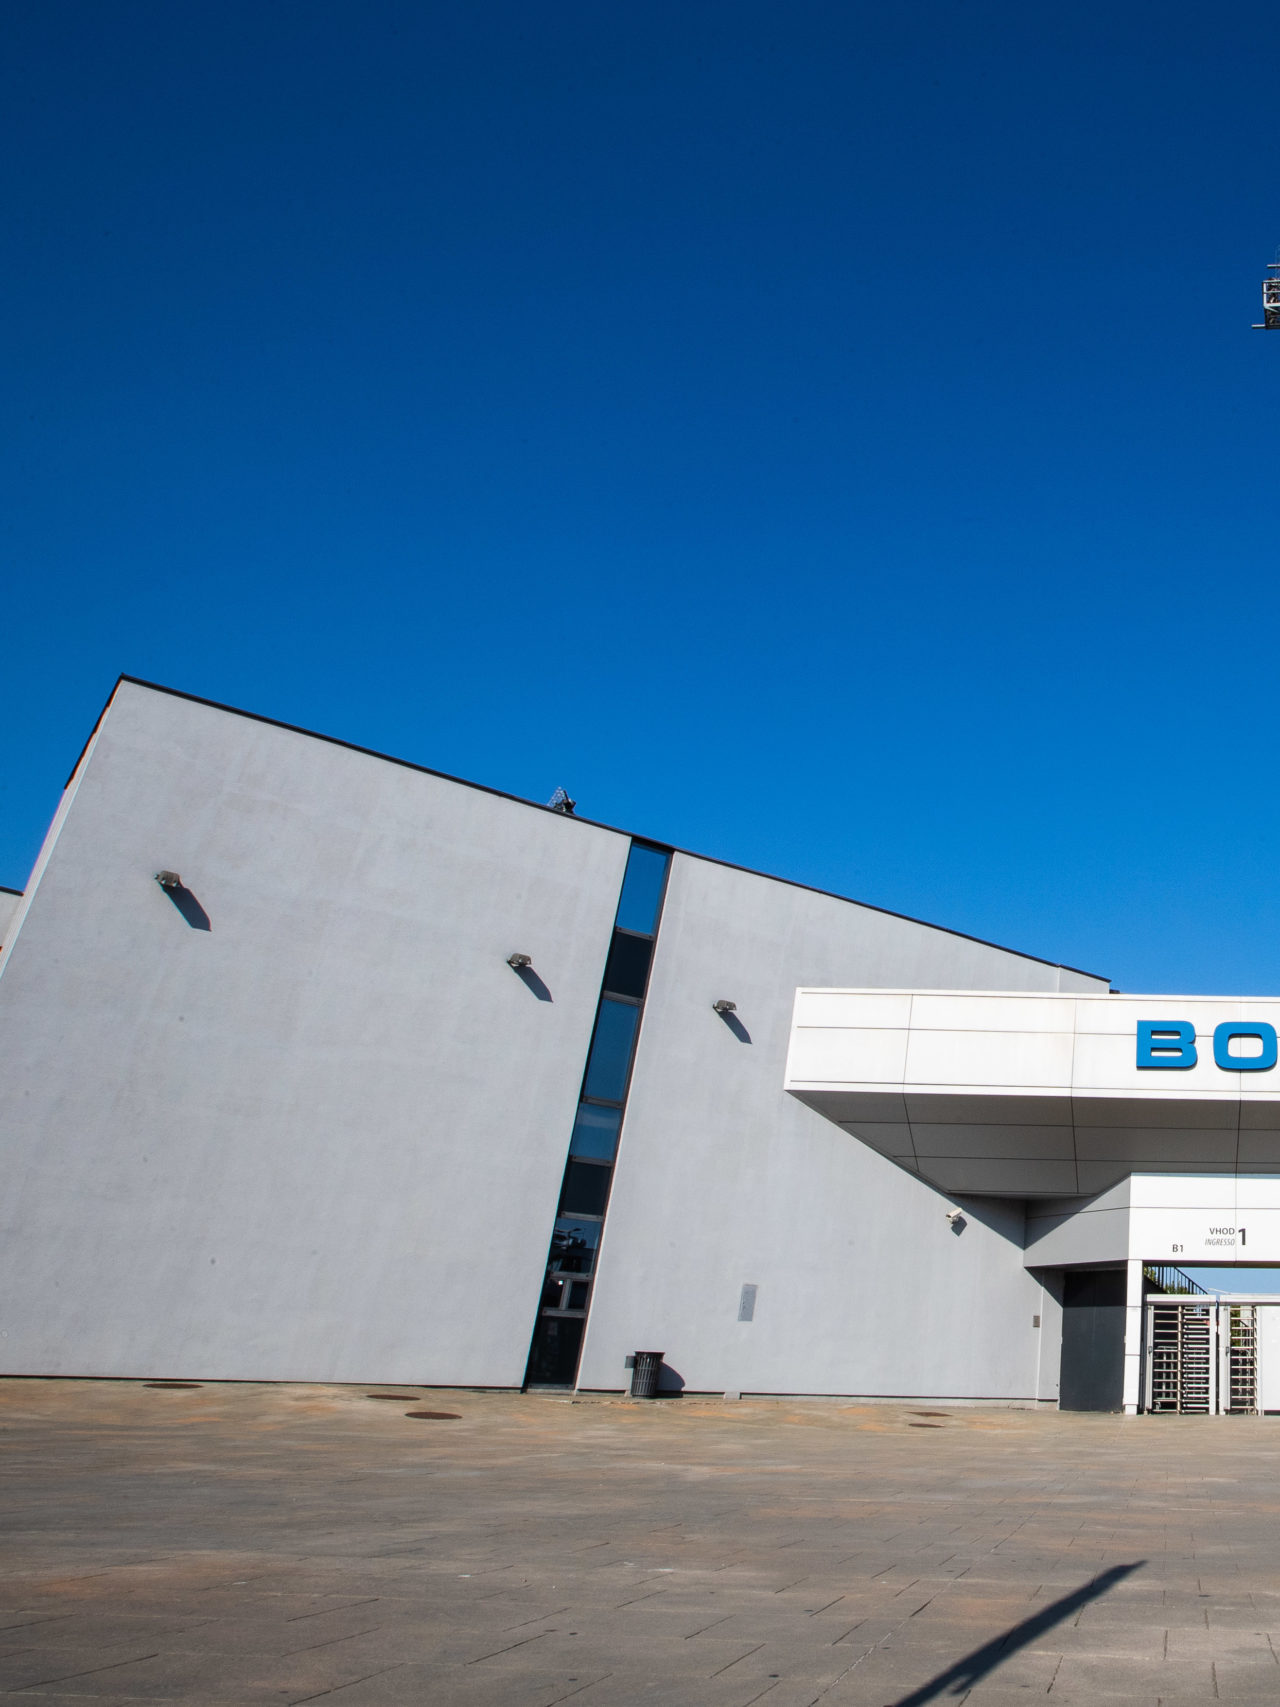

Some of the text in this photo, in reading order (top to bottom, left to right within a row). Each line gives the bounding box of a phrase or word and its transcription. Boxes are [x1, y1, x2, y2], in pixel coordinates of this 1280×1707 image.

[1209, 1227, 1235, 1235] VHOD
[1238, 1228, 1247, 1246] 1
[1204, 1238, 1236, 1246] INGRESSO
[1172, 1244, 1184, 1253] B1
